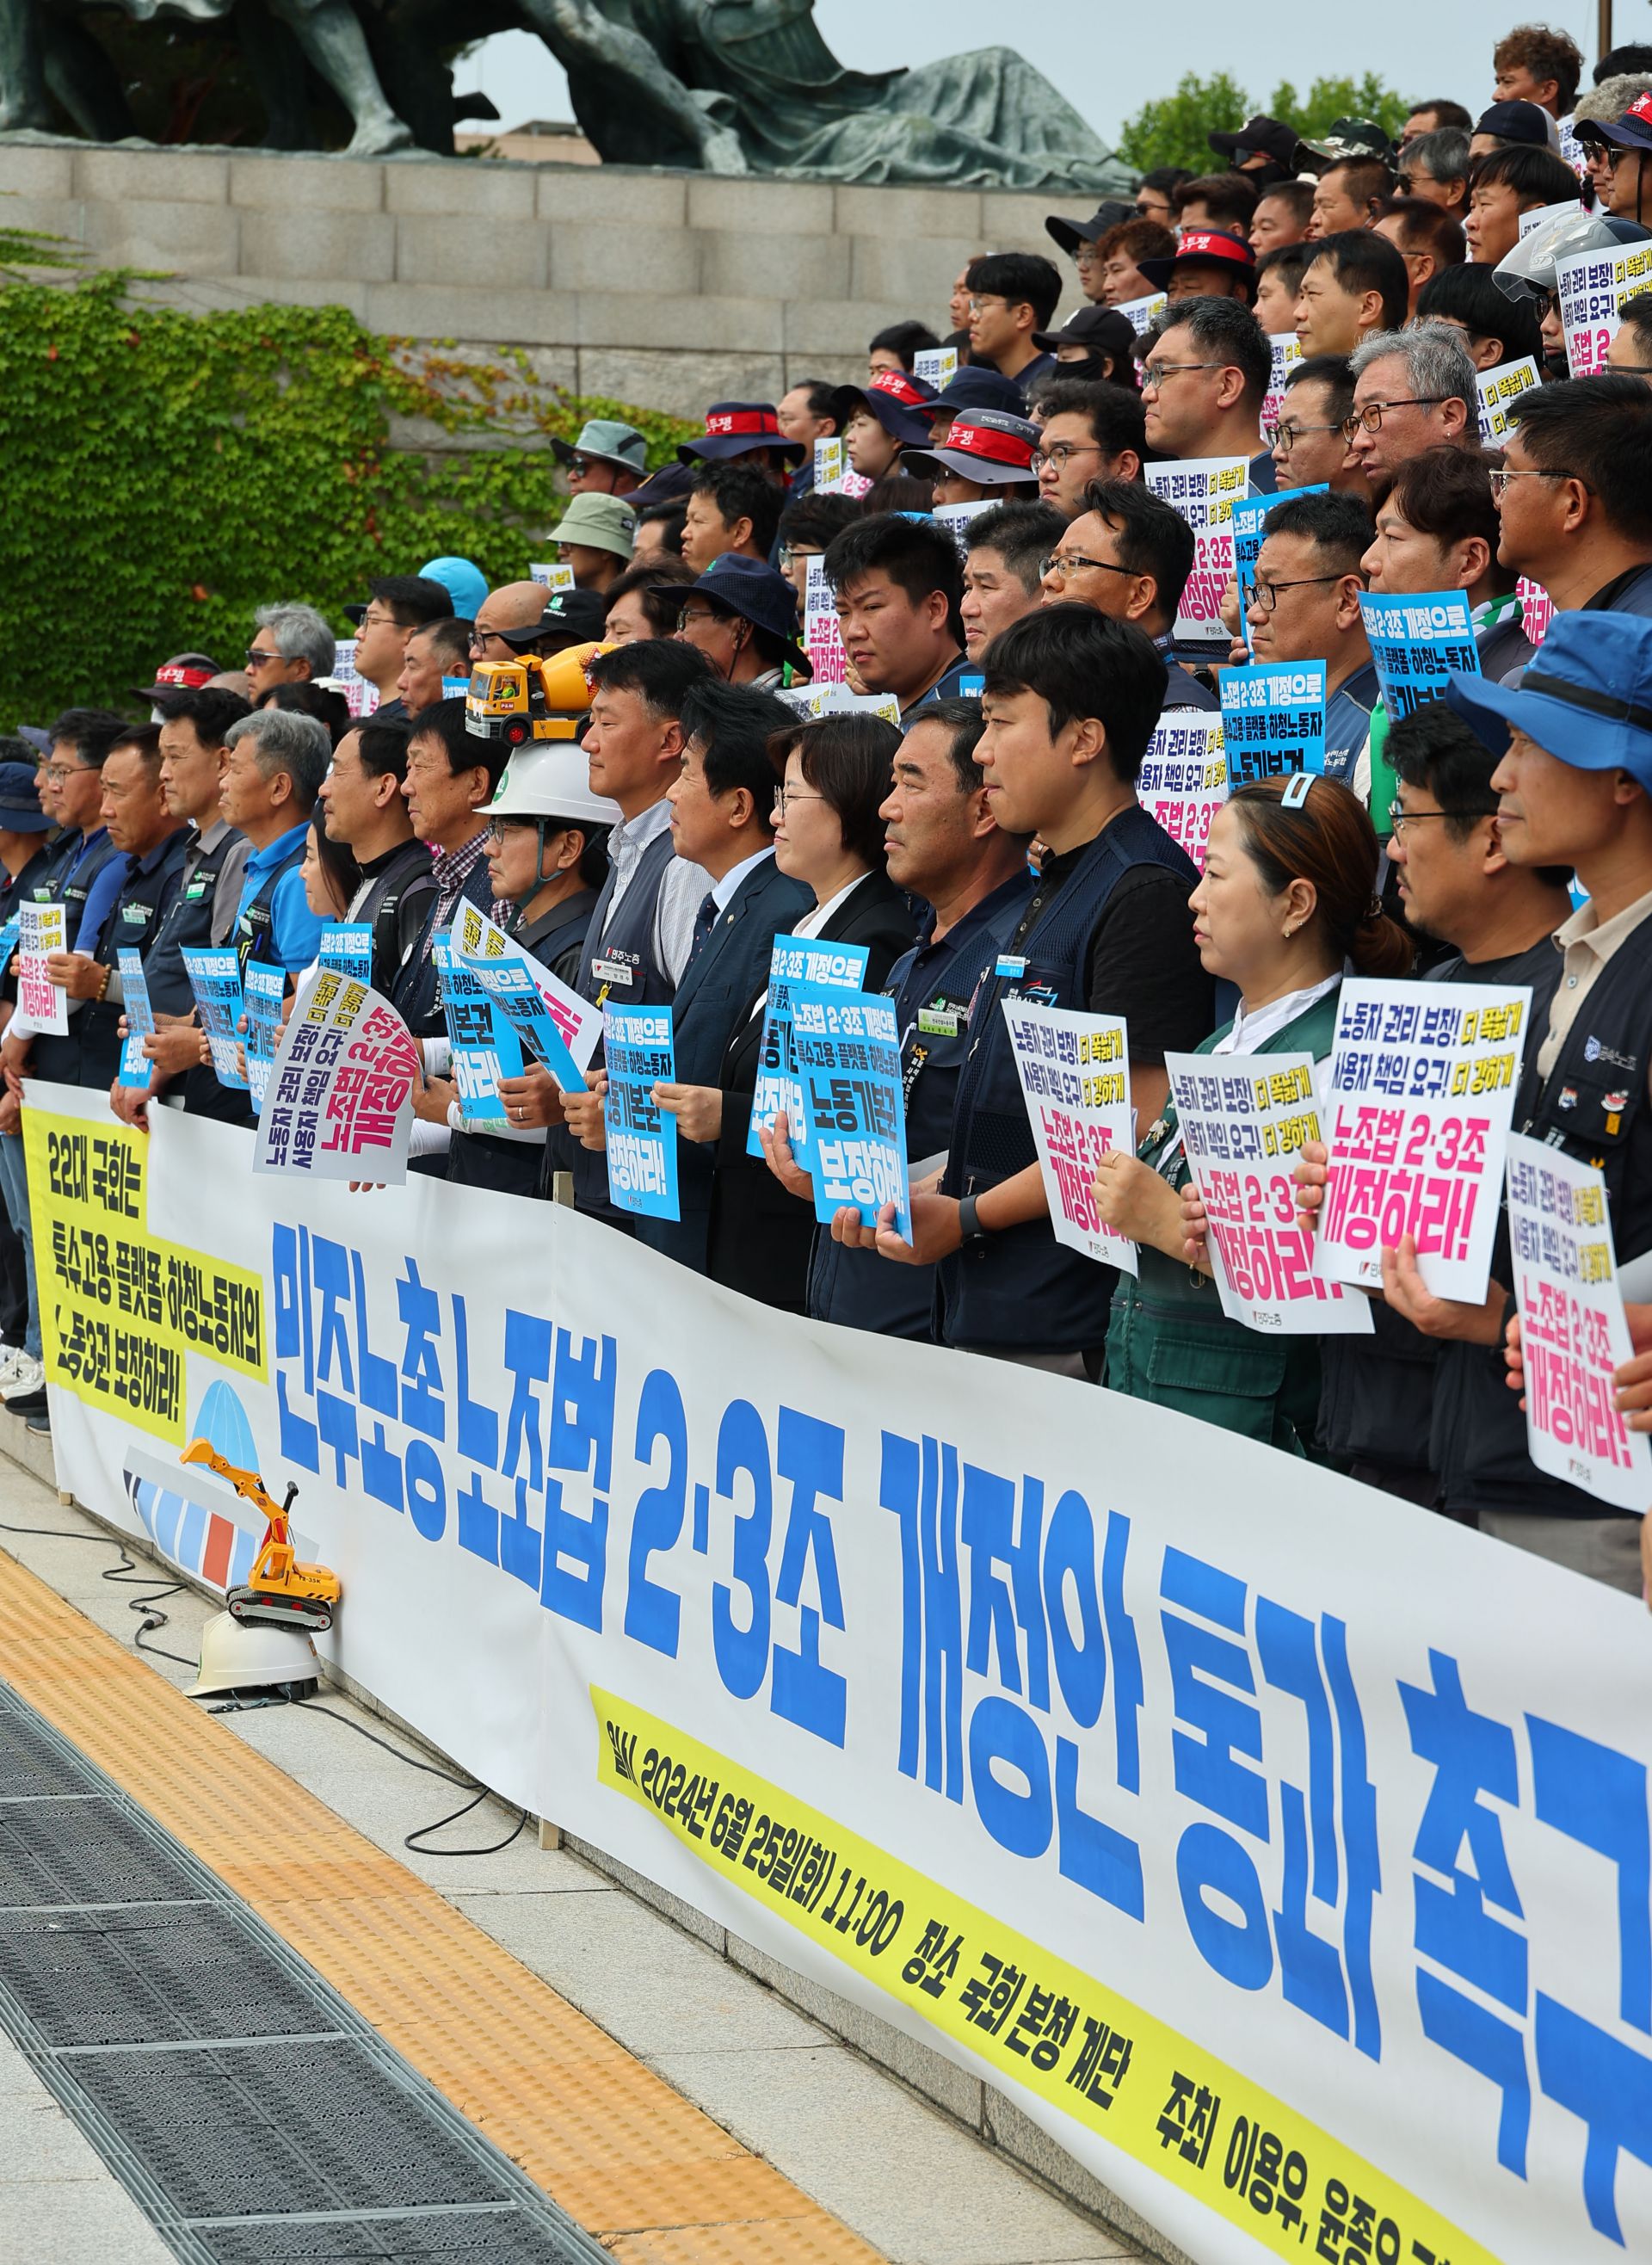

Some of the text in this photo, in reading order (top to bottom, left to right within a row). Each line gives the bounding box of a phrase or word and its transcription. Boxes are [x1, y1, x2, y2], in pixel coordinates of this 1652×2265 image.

[1572, 267, 1586, 294] 권리
[1588, 262, 1613, 289] 보장!
[1615, 261, 1625, 284] 더
[1590, 294, 1614, 320] 요구!
[1569, 330, 1592, 368] 노조법
[1485, 364, 1535, 406] 더 폭넓게
[1492, 411, 1506, 435] 더
[1172, 475, 1187, 497] 권리
[1188, 474, 1208, 498] 보장!
[1208, 473, 1218, 496] 더
[1218, 464, 1245, 491] 폭넓게
[1191, 503, 1218, 528] 요구! 더
[1234, 509, 1255, 535] 노조법
[810, 617, 830, 644] 노조법
[1377, 609, 1404, 639] 2·3조
[1403, 605, 1470, 639] 개정으로
[1221, 674, 1322, 710] 노조법 2·3조 개정으로
[1145, 728, 1215, 757] 동자 권리 보장! 더
[1163, 763, 1185, 793] 책임
[1186, 763, 1205, 793] 요구!
[1205, 763, 1212, 790] 더
[344, 932, 370, 954] 개정으로
[805, 952, 863, 989] 개정으로
[625, 1016, 669, 1046] 개정으로
[792, 1002, 825, 1035] 노조법
[827, 1006, 864, 1040] 2·3조
[865, 1006, 897, 1043] 개정으로
[1010, 1019, 1124, 1067] 노동자 권리 보장! 더 폭넓게
[1340, 1000, 1525, 1049] 노동자 권리 보장! 더 폭넓게
[266, 972, 343, 1167] 노동자 권리 보장! 더 폭넓게
[293, 982, 369, 1170] 사용자 책임 요구! 더 강하게
[321, 1005, 403, 1153] 노조법 2·3조
[1021, 1059, 1125, 1109] 사용자 책임 요구! 더 강하게
[1171, 1064, 1314, 1115] 노동자 권리 보장! 더 폭넓게
[1332, 1052, 1516, 1100] 사용자 책임 요구! 더 강하게
[809, 1077, 898, 1144] 노동기본권
[1039, 1104, 1075, 1162] 노조법
[1181, 1112, 1322, 1163] 사용자 책임 요구! 더 강하게
[1331, 1103, 1491, 1174] 노조법 2·3조
[47, 1131, 142, 1219] 22대 국회는
[607, 1131, 667, 1196] 보장하라!
[817, 1138, 905, 1215] 보장하라!
[1198, 1167, 1243, 1222] 노조법
[1324, 1163, 1478, 1262] 개정하라!
[1523, 1274, 1570, 1352] 노조법
[55, 1305, 180, 1423] 노동3권 보장하라!
[1526, 1342, 1633, 1470] 개정하라!
[272, 1221, 1652, 2250] 민주노총 노조법 2·3조 개정안 통과 촉구
[606, 1720, 638, 1788] 일시
[640, 1748, 720, 1840] 2024년
[710, 1792, 756, 1861] 6월
[743, 1813, 837, 1914] 25일(화)
[820, 1867, 904, 1957] 11:00
[902, 1918, 965, 2000] 장소
[959, 1952, 1028, 2036] 국회
[1004, 1983, 1080, 2072] 본청
[1065, 2016, 1134, 2112] 계단
[1156, 2071, 1221, 2170] 주최
[1224, 2114, 1308, 2244] 이용우,
